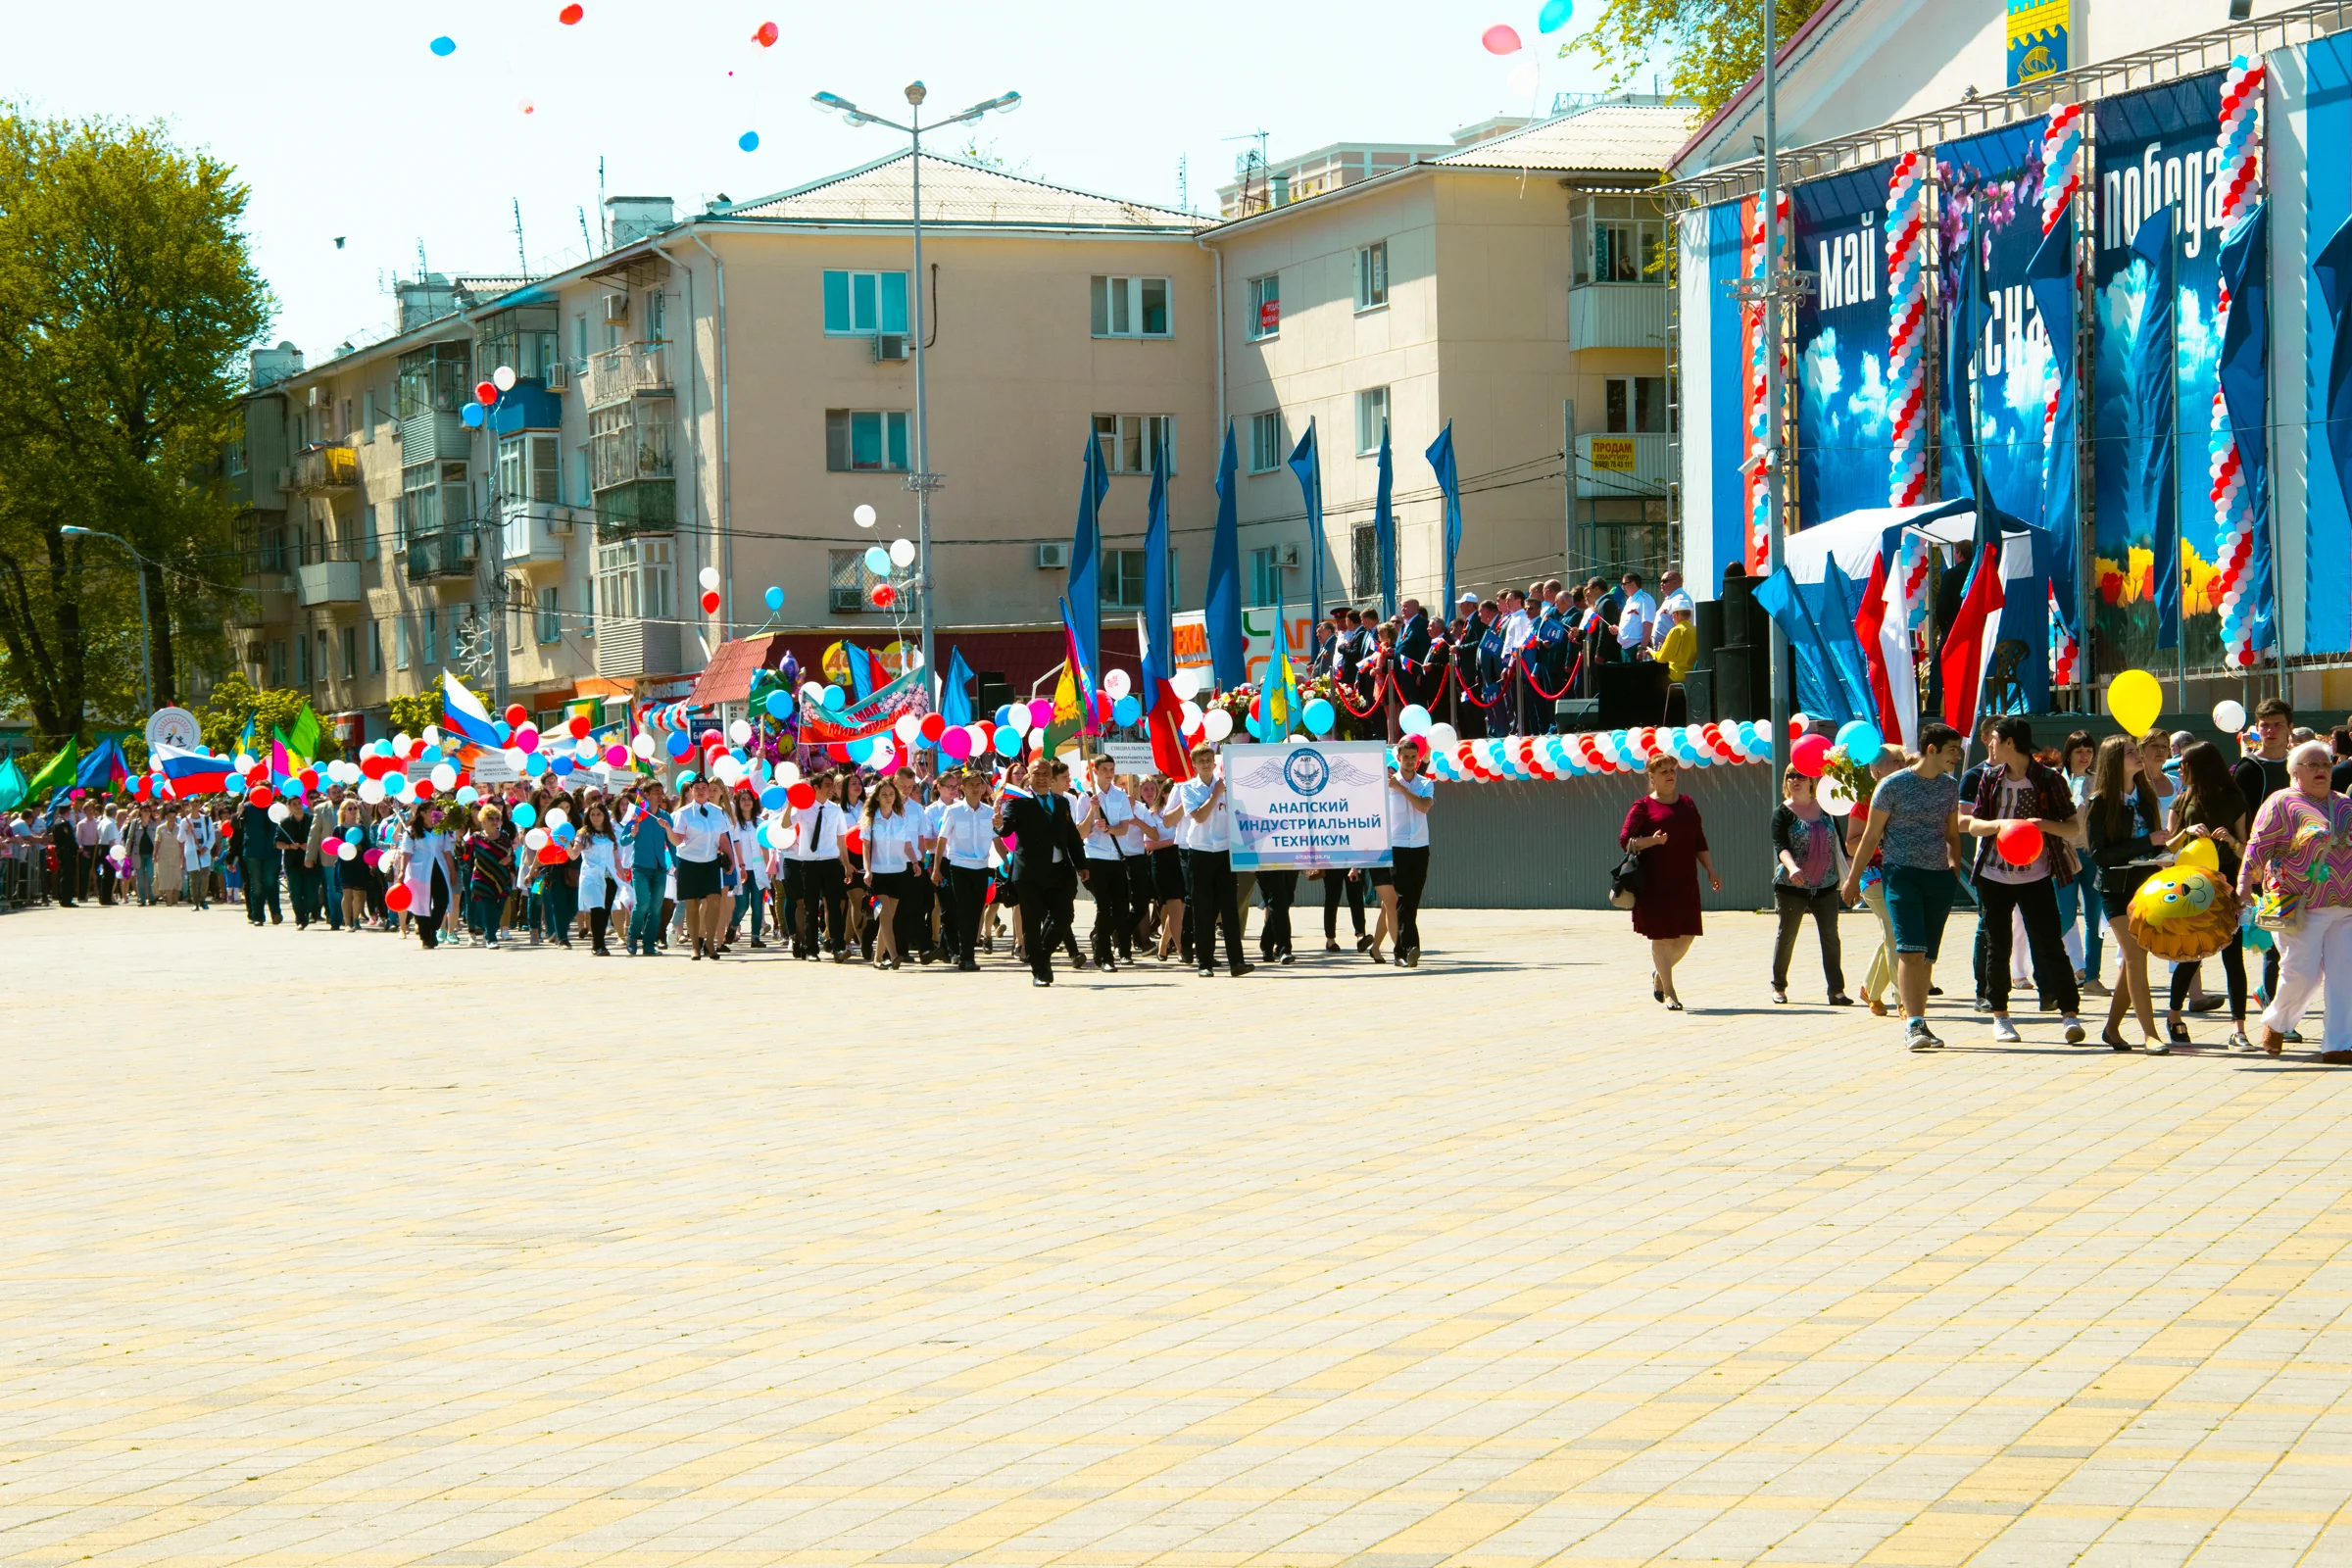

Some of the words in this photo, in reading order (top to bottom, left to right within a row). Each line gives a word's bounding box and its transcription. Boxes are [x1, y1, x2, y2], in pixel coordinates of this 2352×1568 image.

[2104, 142, 2224, 258] победа
[1820, 211, 1876, 311] май
[1593, 442, 1632, 454] ПРОДАМ
[853, 702, 882, 721] МАЯ
[1269, 799, 1348, 814] АНАПСКИЙ
[1239, 814, 1382, 833] ИНДУСТРИАЛЬНЫЙ
[1272, 835, 1350, 848] ТЕХНИКУМ
